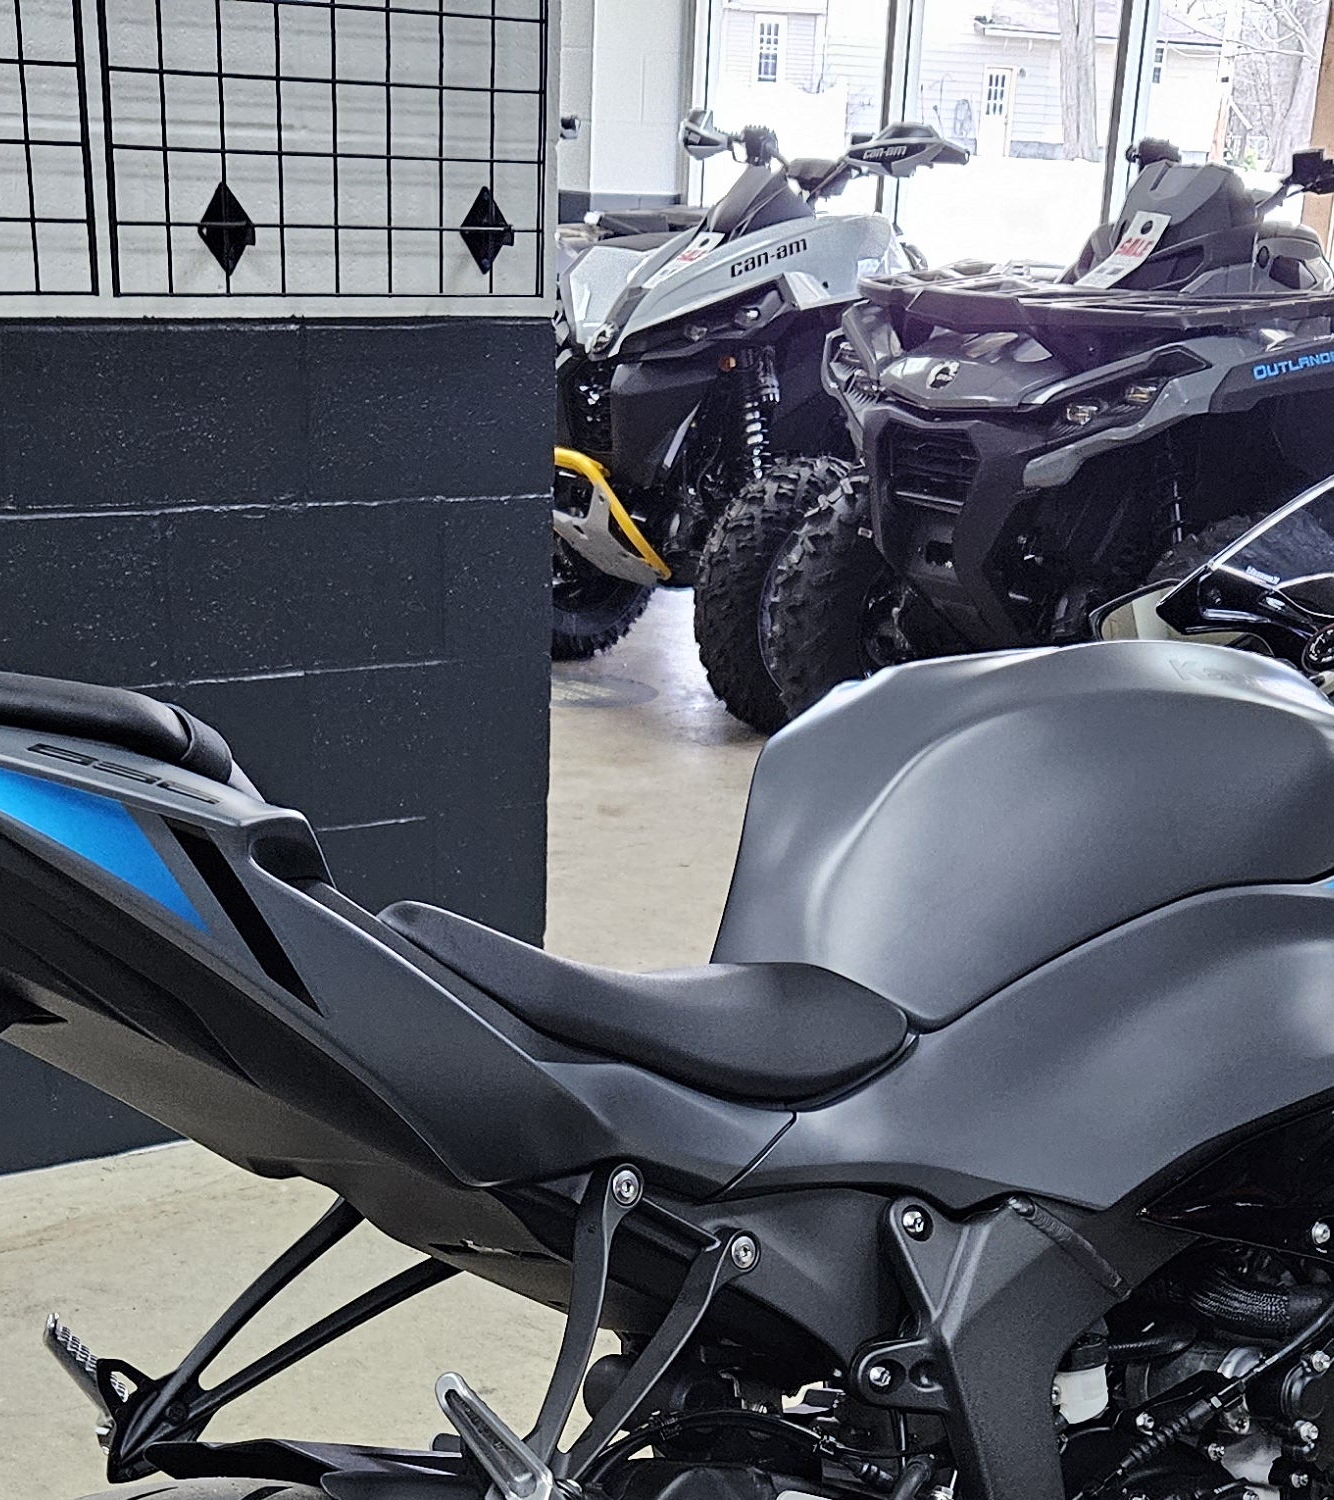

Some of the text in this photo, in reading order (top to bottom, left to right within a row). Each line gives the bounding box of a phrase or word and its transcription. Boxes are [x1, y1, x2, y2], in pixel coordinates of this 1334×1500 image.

[863, 145, 908, 160] can-am
[1114, 237, 1156, 257] SALE
[729, 237, 809, 279] can-am
